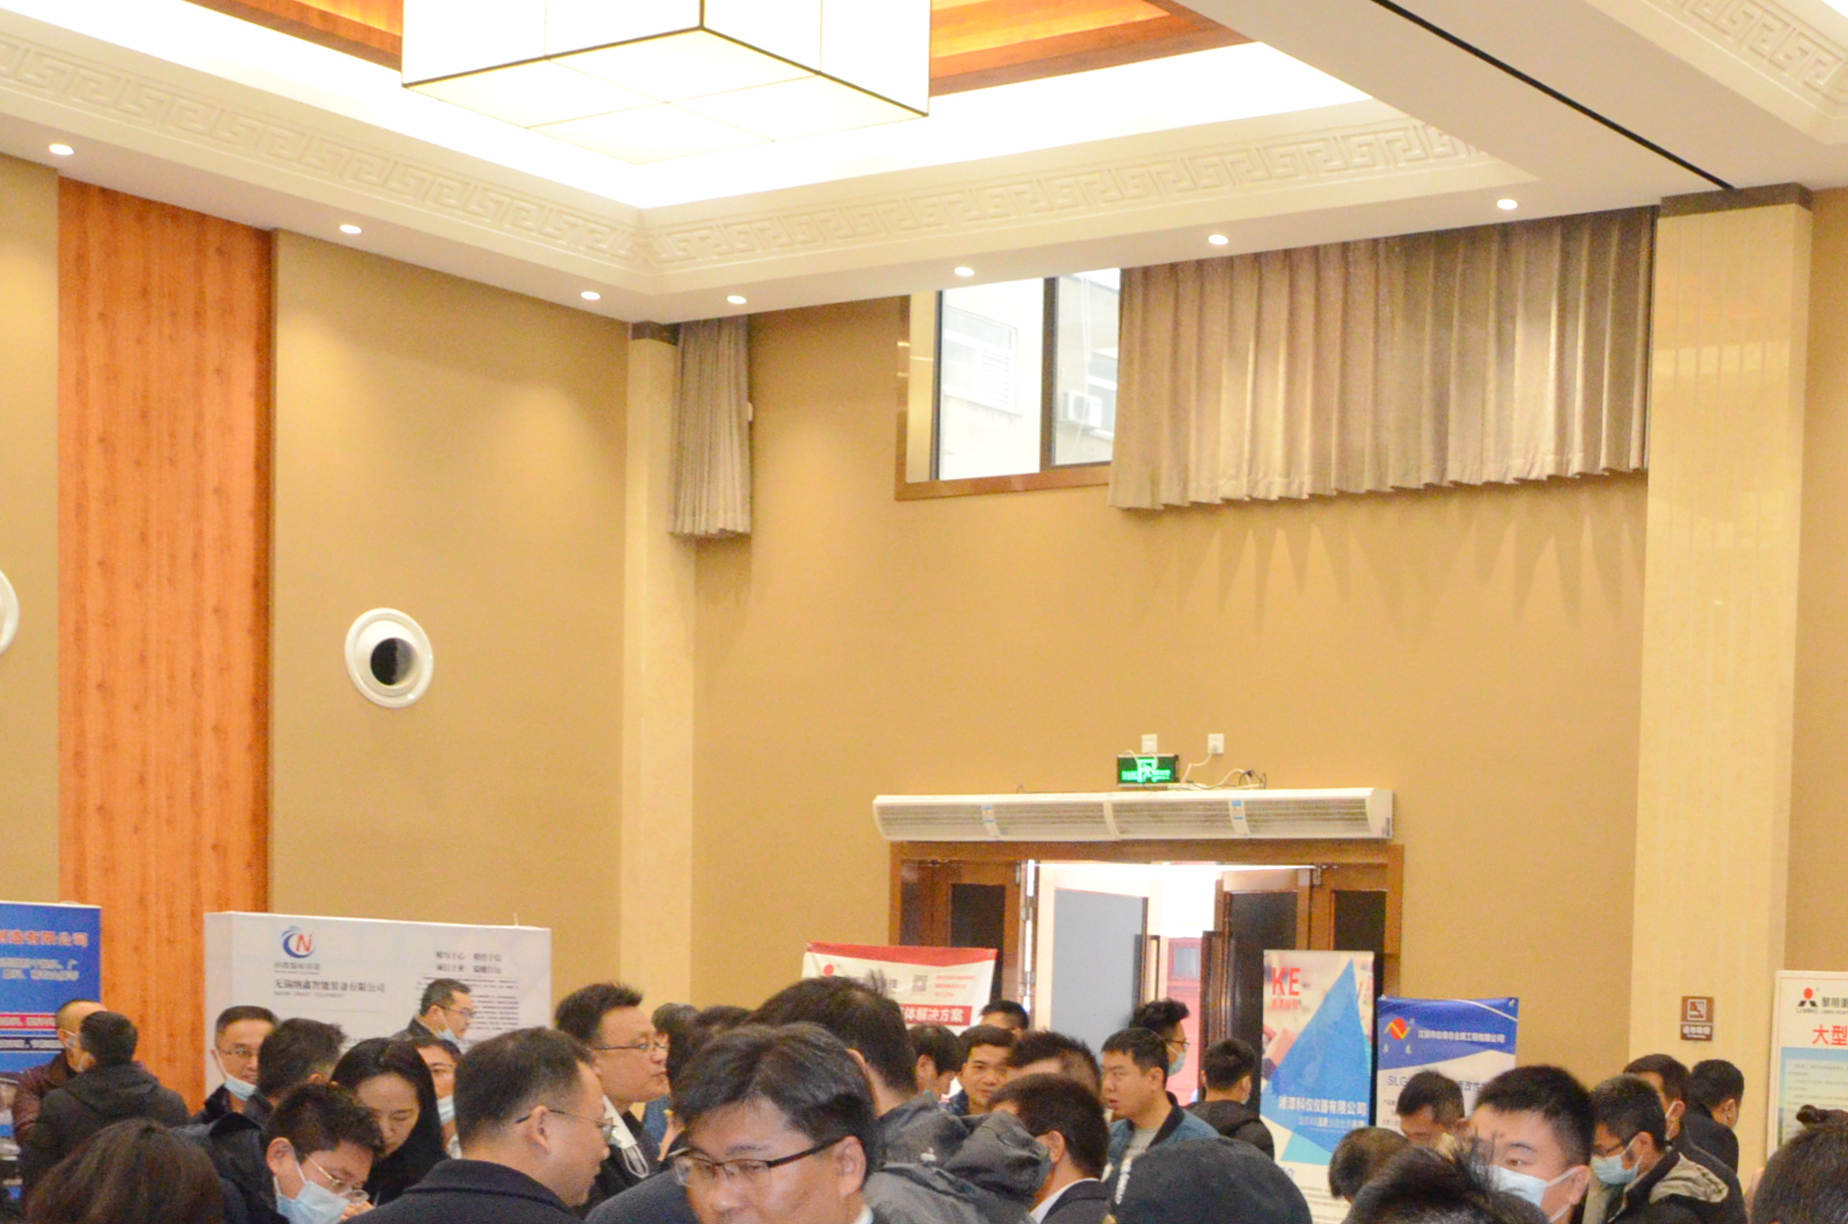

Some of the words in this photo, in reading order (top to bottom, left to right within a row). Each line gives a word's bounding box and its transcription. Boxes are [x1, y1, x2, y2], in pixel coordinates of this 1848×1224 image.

[902, 1006, 964, 1023] 体解决方案
